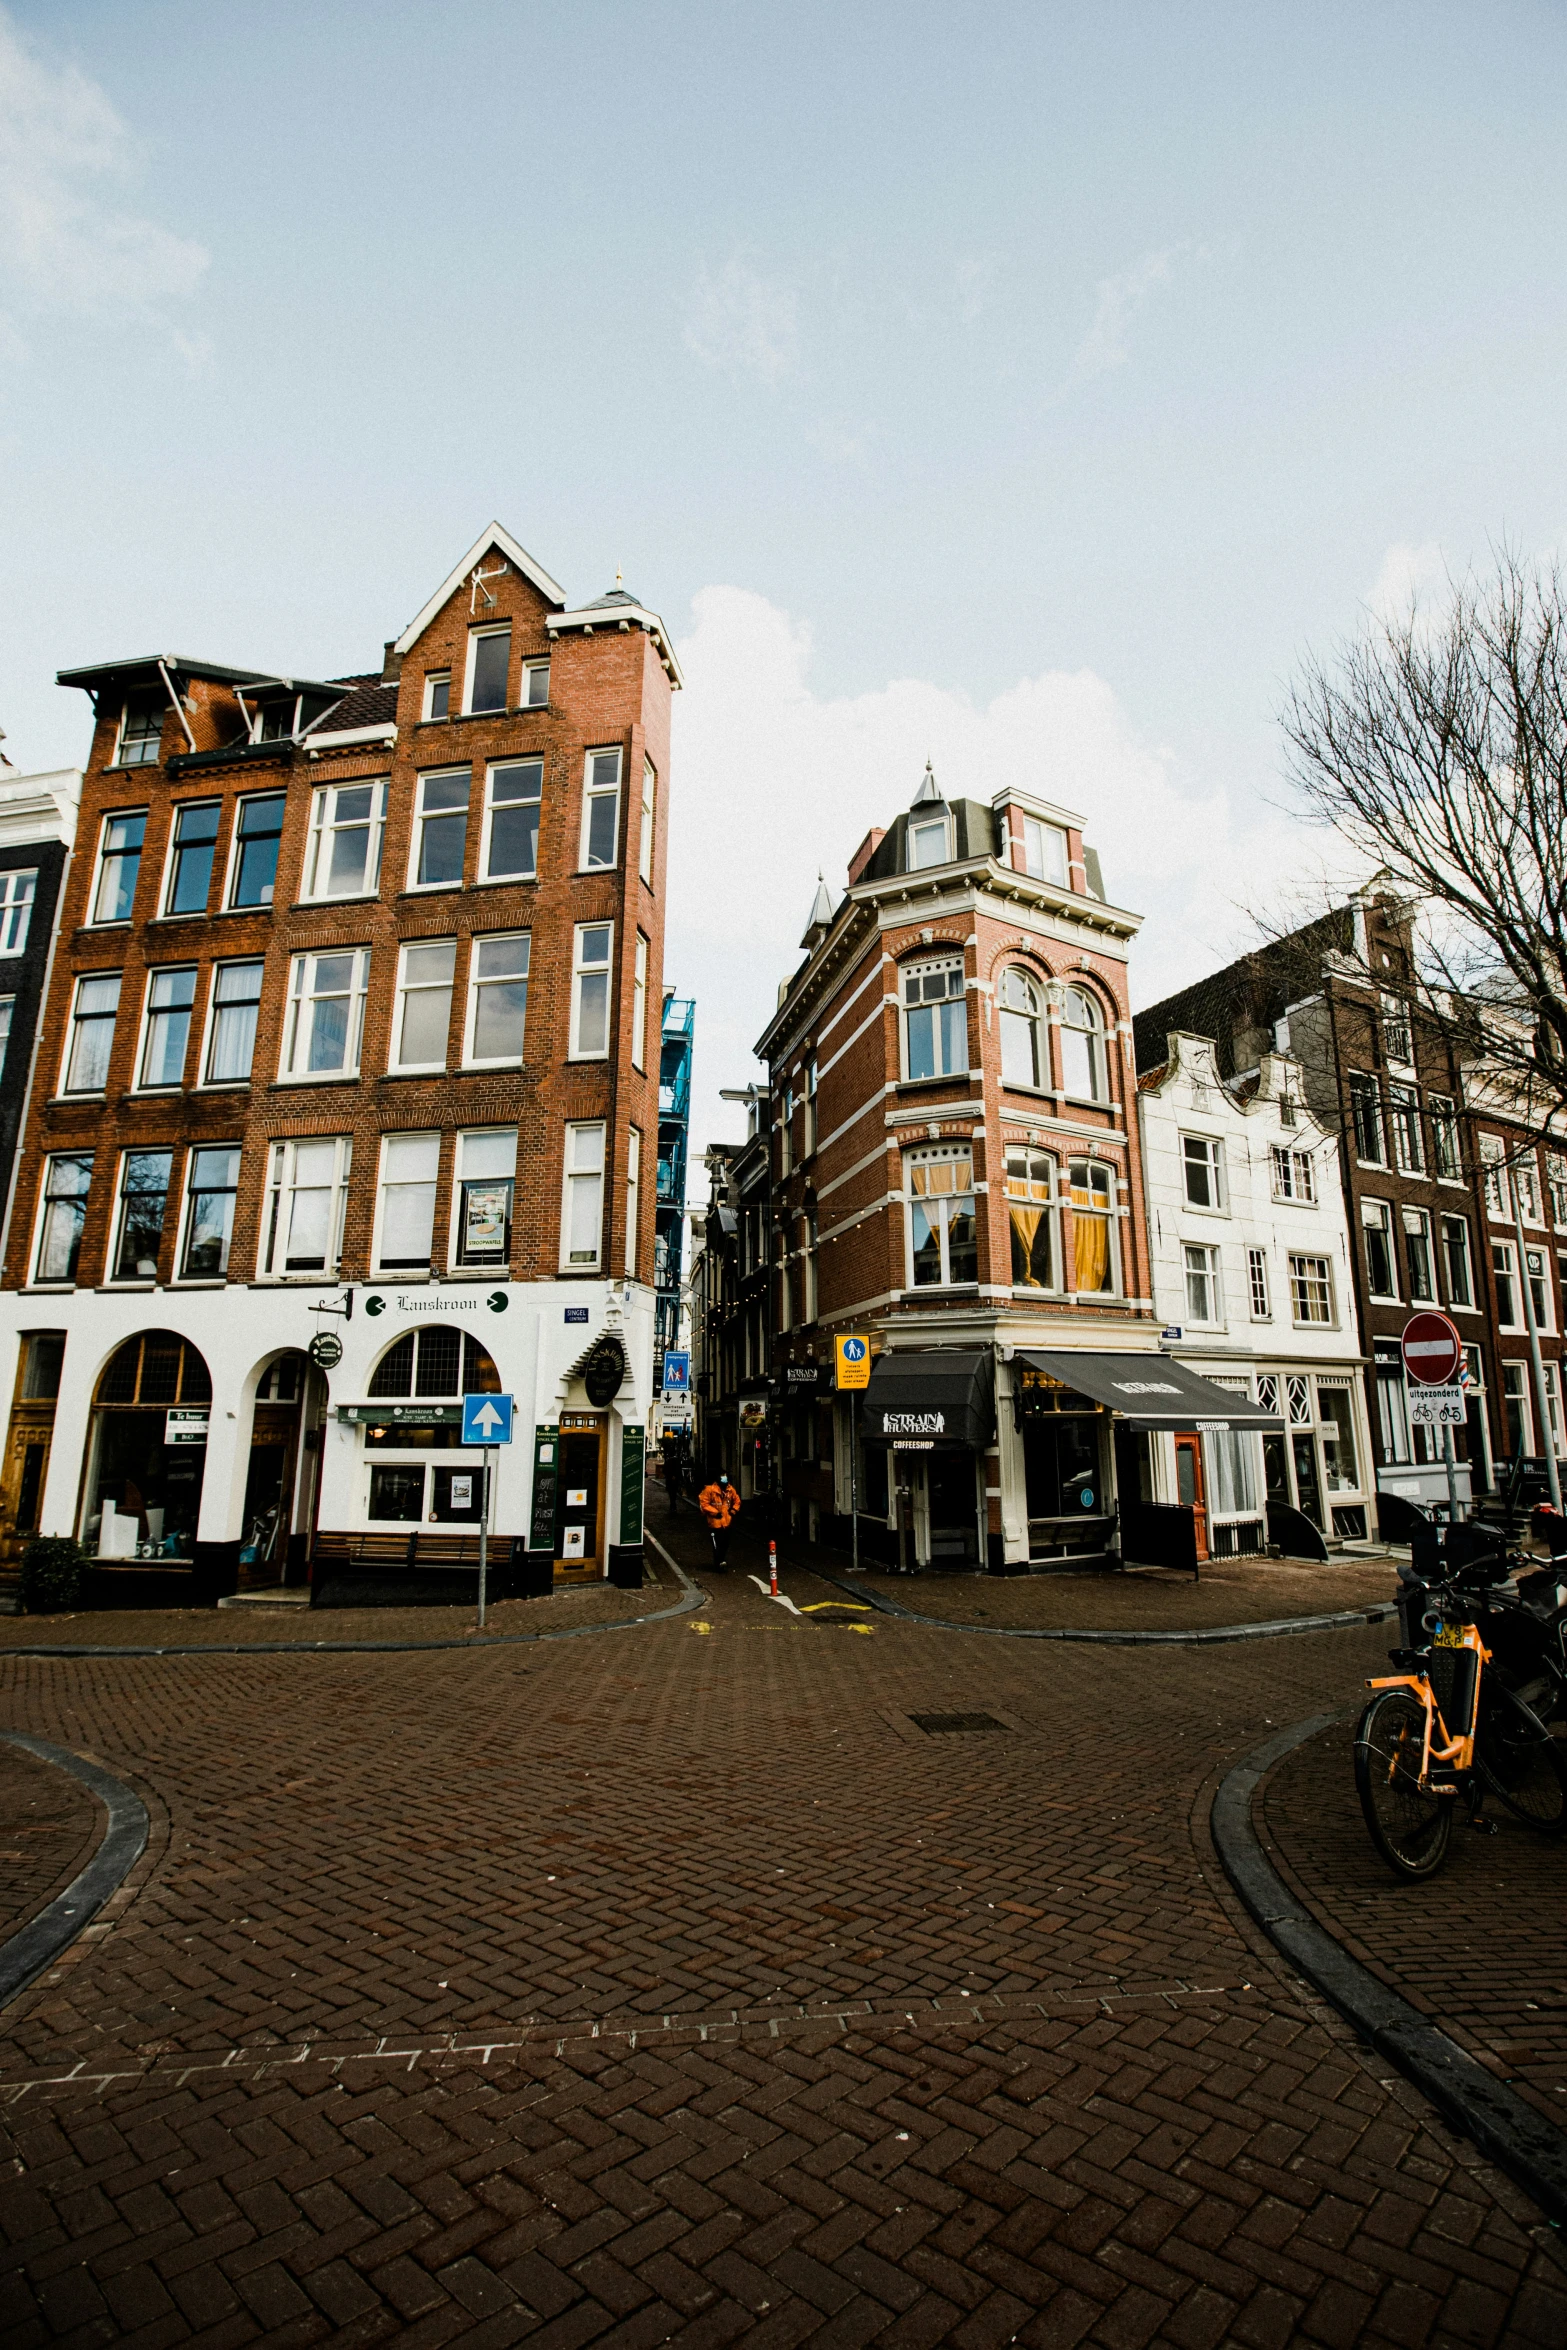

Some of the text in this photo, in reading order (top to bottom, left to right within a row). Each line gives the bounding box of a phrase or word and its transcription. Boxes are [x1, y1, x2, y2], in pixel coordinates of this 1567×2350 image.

[397, 1296, 477, 1313] Lanskroon
[567, 1309, 586, 1317] SINGEL
[588, 1348, 623, 1371] LANSKROON
[1410, 1389, 1460, 1400] uitgezonderd
[176, 1412, 203, 1420] Te huur
[889, 1413, 938, 1425] STRAIN
[888, 1423, 938, 1433] HUNTERS
[1196, 1421, 1230, 1431] COFFEESHOP
[893, 1440, 935, 1449] COFFEESHOP
[538, 1491, 548, 1503] at
